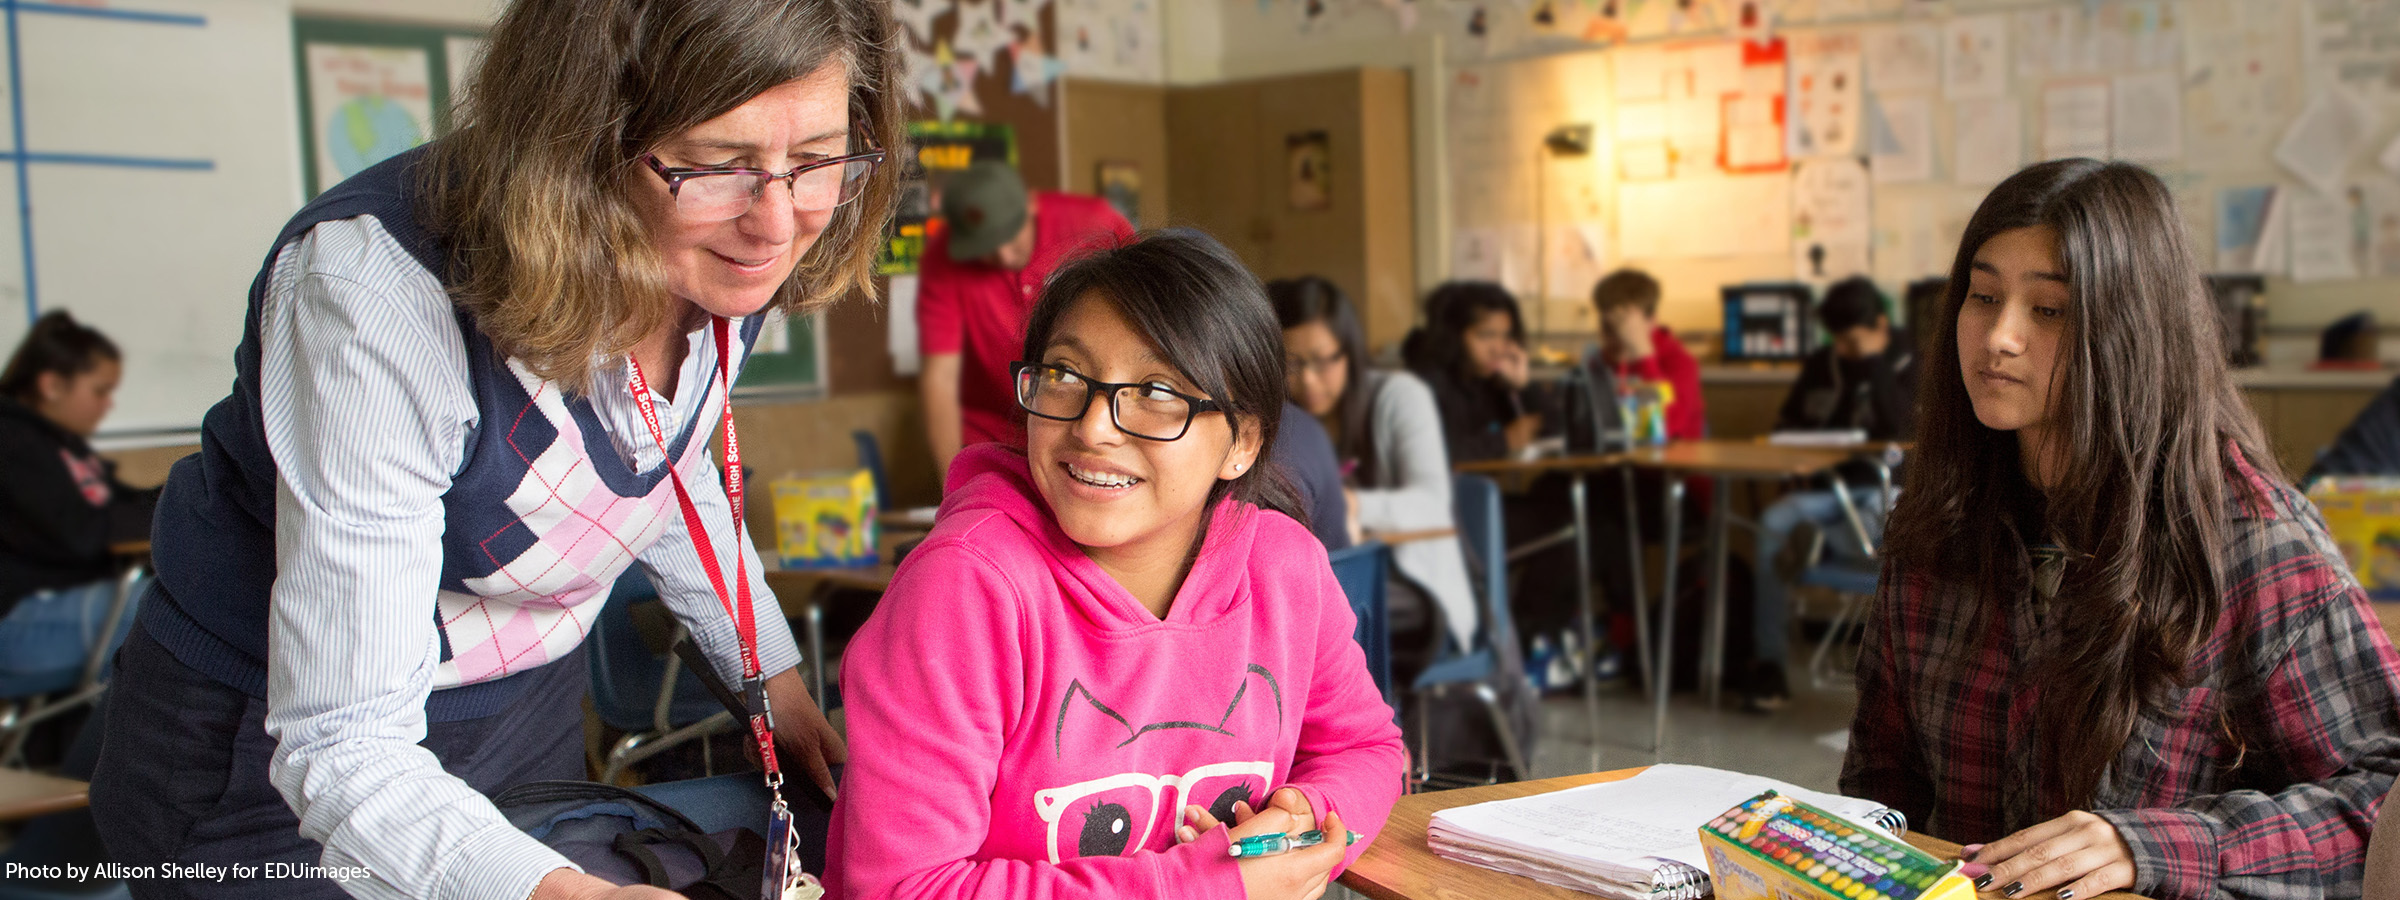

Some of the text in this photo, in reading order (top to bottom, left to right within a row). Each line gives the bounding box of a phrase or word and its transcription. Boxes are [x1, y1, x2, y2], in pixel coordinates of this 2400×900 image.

[637, 391, 662, 439] SCHOOL
[726, 416, 739, 464] SCHOOL
[729, 464, 741, 494] HIGH
